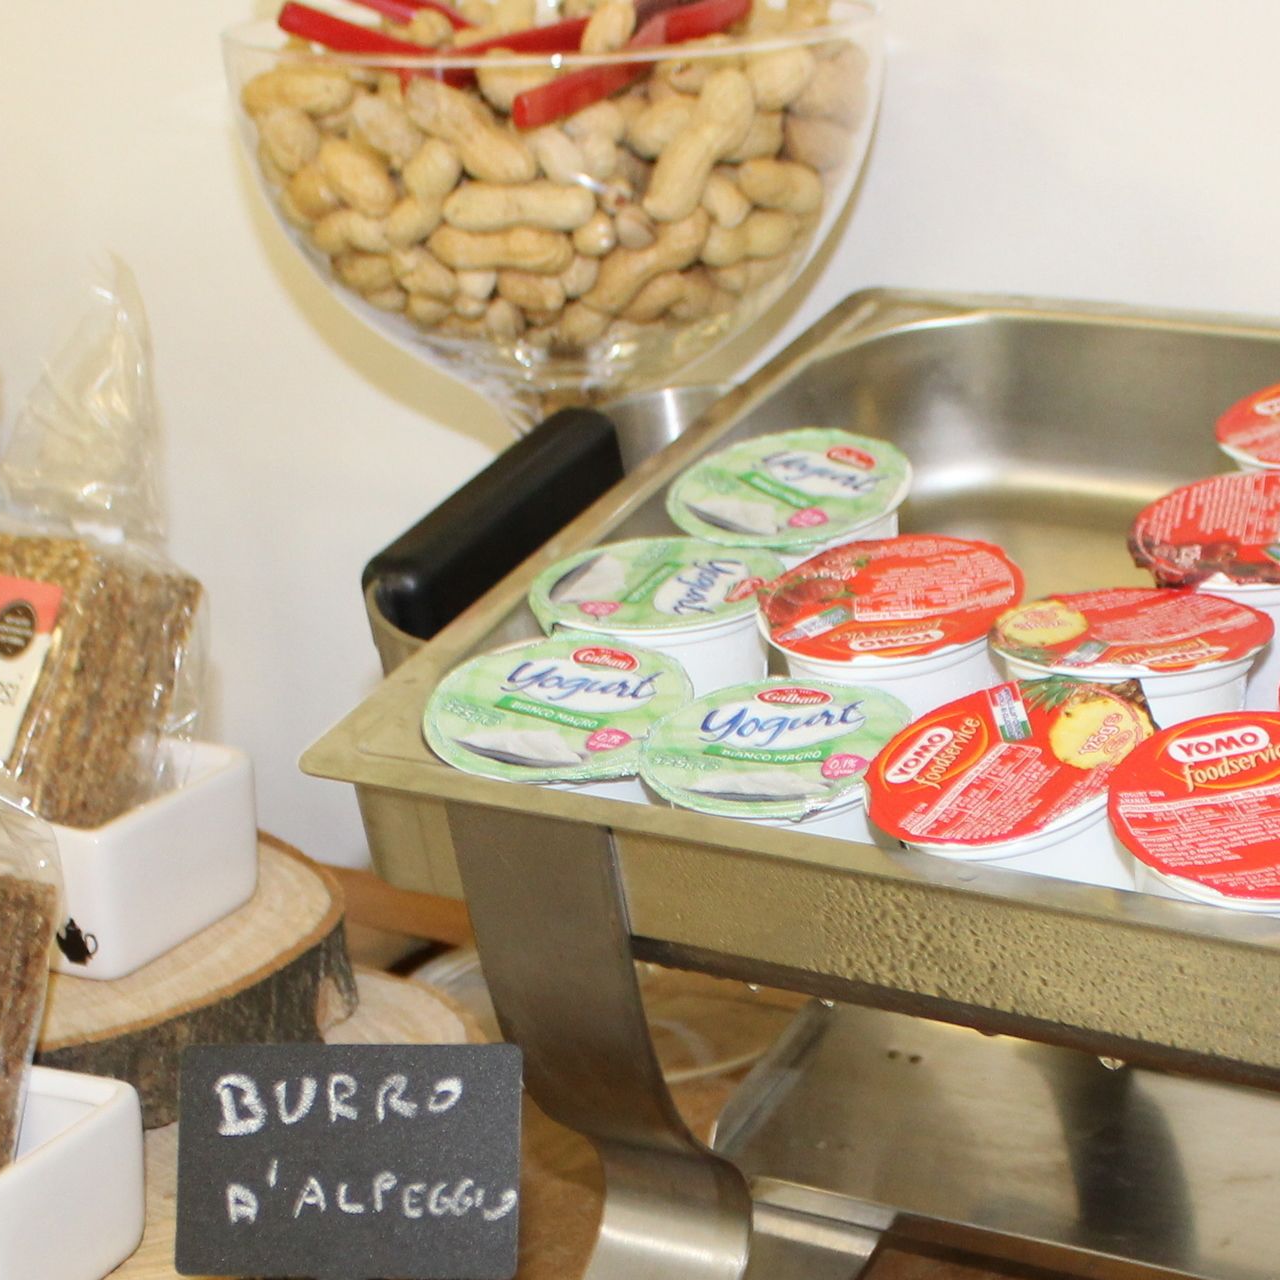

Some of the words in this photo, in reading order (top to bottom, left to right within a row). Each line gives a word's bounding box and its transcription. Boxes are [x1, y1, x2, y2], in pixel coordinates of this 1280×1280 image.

[858, 632, 934, 649] YOMO
[500, 661, 664, 701] Yogurt
[510, 700, 555, 719] BIANCO
[556, 711, 600, 728] MAGRO
[698, 700, 867, 747] Yogurt
[721, 749, 772, 761] BIANCO
[773, 750, 823, 762] MAGRO
[894, 732, 946, 779] YOMO
[912, 716, 981, 791] foodservice
[1176, 730, 1261, 758] YOMO
[214, 1073, 464, 1136] BURRO
